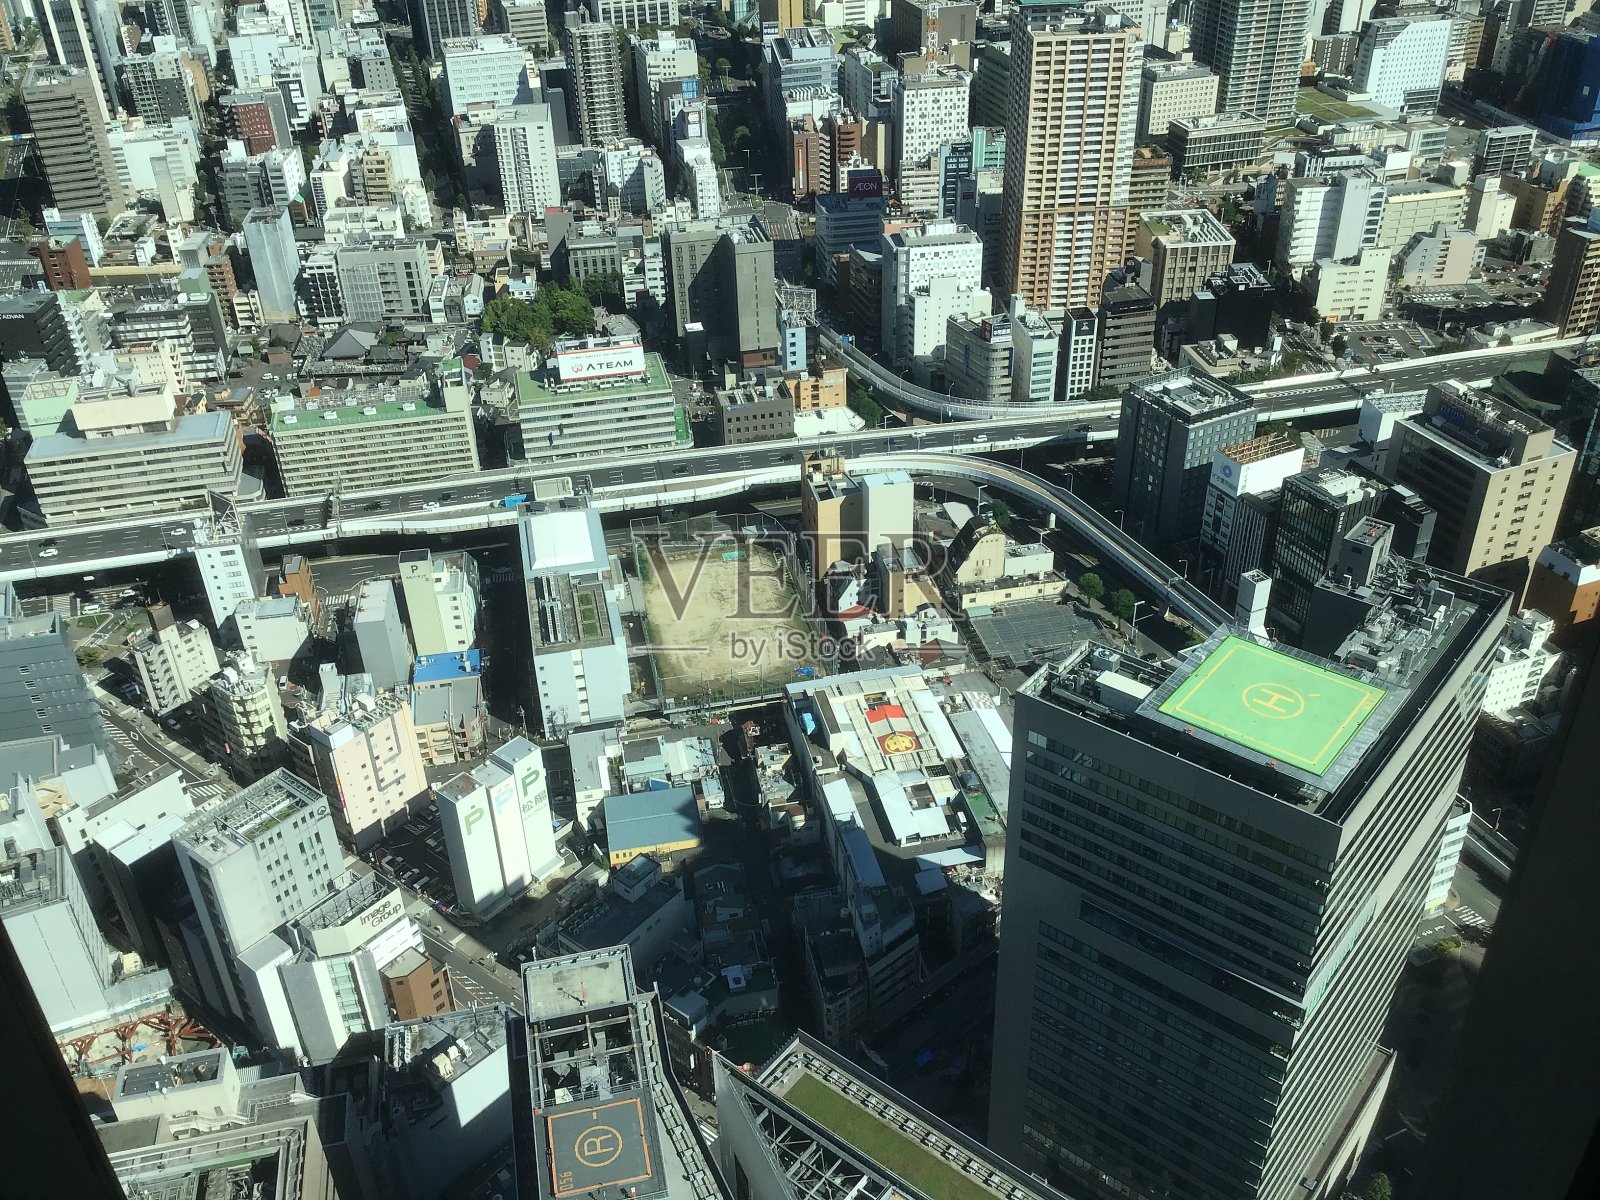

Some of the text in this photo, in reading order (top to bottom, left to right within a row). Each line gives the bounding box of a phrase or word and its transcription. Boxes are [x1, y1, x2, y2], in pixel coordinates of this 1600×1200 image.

[586, 360, 633, 371] ATEAM
[411, 565, 419, 573] P
[520, 769, 540, 797] P
[464, 807, 485, 836] P
[360, 899, 392, 926] Image
[371, 902, 402, 928] Group
